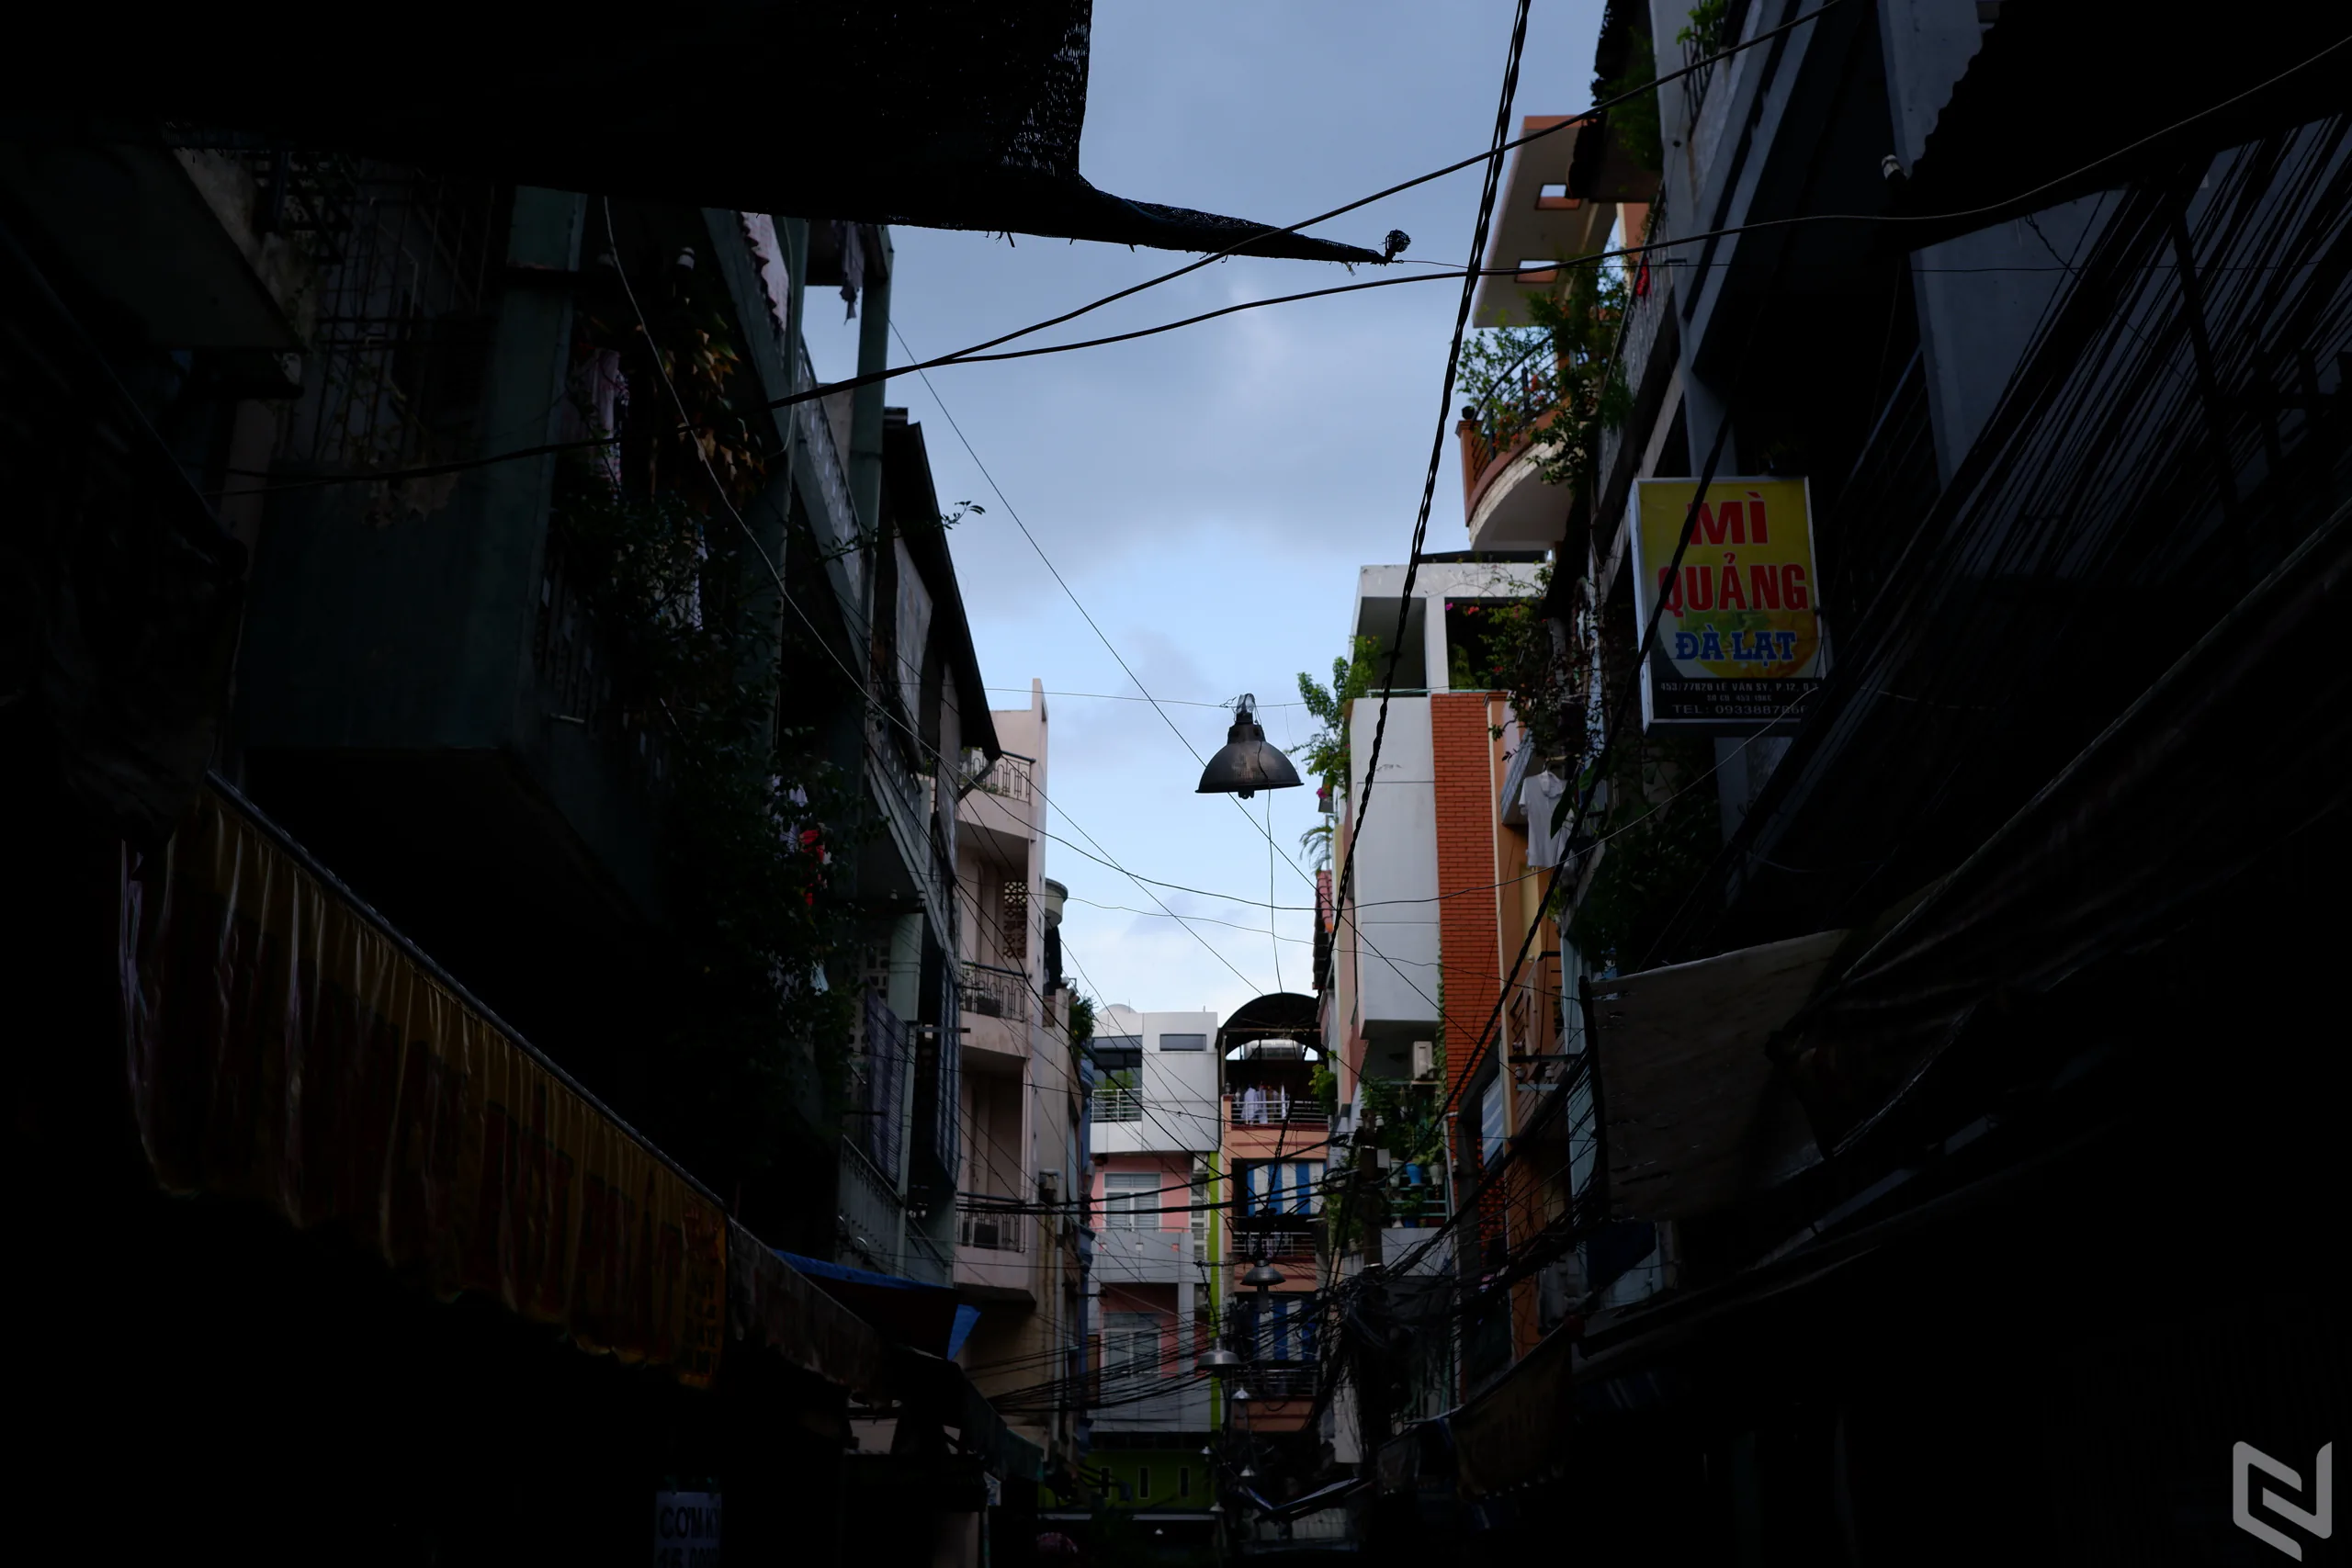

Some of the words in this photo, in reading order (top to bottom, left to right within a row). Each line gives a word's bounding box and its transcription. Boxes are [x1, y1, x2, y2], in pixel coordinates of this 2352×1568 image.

[1687, 491, 1769, 546] MÌ
[1657, 552, 1809, 618] QUẢNG
[1675, 625, 1724, 660] ĐÀ
[1731, 631, 1797, 667] LẠT
[1671, 704, 1709, 715] TEL:
